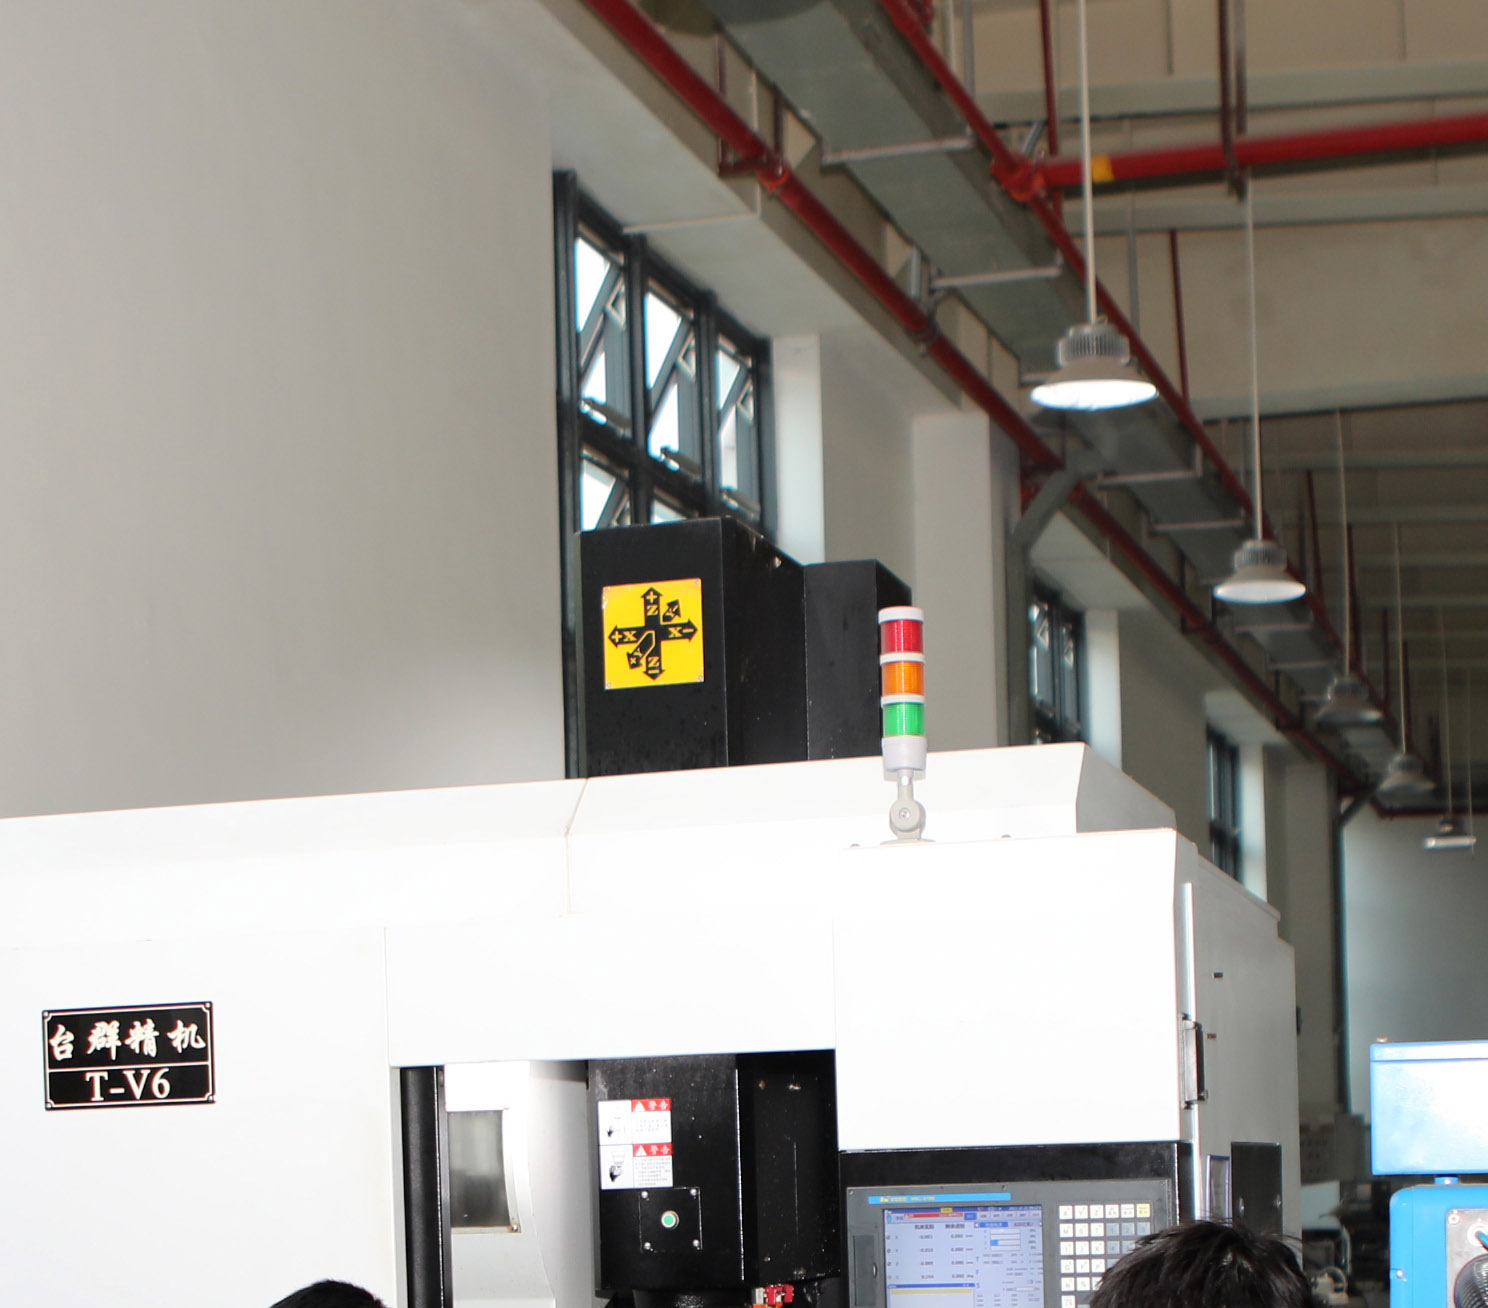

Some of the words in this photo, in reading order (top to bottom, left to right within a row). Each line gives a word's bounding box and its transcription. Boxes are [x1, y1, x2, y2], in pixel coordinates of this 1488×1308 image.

[48, 1018, 207, 1061] 台群精机
[85, 1067, 171, 1101] T-V6
